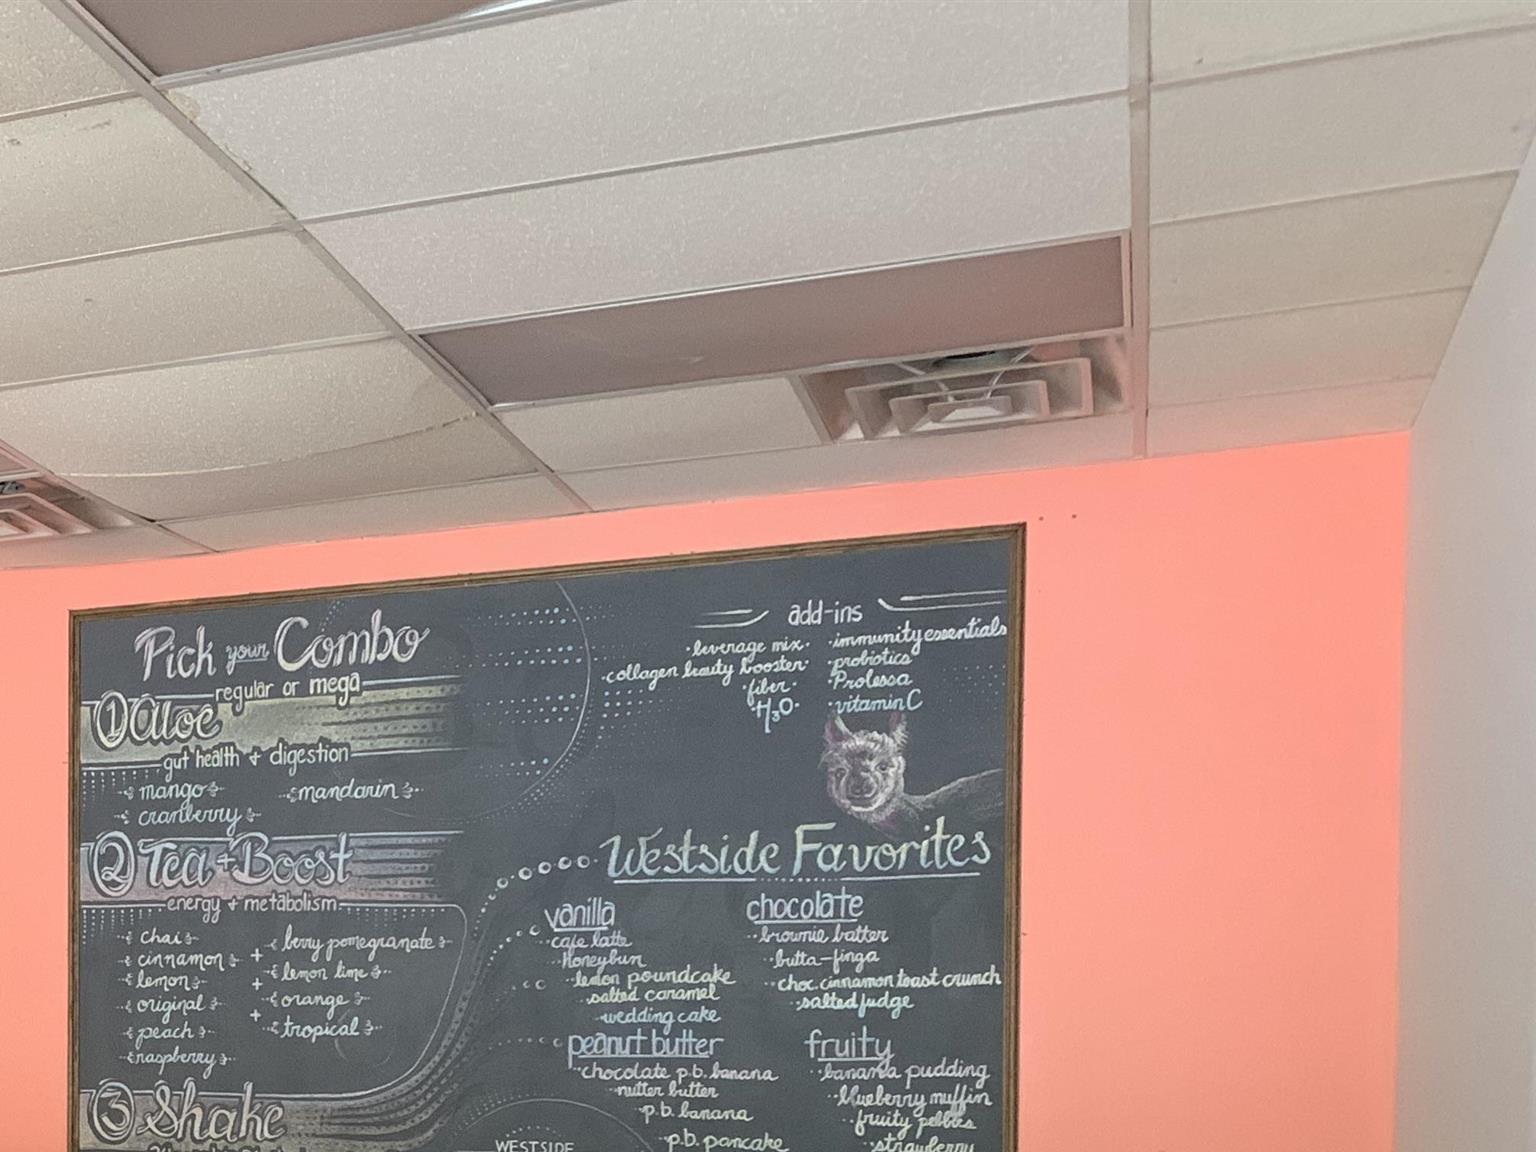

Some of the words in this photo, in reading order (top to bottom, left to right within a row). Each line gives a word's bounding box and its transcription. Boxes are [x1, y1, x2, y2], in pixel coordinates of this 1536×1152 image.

[787, 599, 863, 625] add-ins
[134, 625, 216, 682] Pick
[225, 642, 270, 674] your
[274, 608, 430, 671] Combo
[692, 640, 766, 662] leverage
[772, 636, 804, 652] mix
[832, 620, 923, 656] immunity
[924, 616, 1007, 641] essentials
[606, 663, 678, 691] collagen
[682, 659, 734, 686] beauty
[739, 656, 806, 675] booster
[830, 647, 913, 677] probiotics
[216, 679, 273, 712] regular
[282, 680, 300, 696] or
[310, 672, 360, 706] mega
[747, 678, 791, 706] fiber
[832, 669, 913, 690] Prolessa
[836, 694, 905, 714] vitamin
[906, 688, 923, 711] C
[164, 751, 188, 782] gut
[196, 746, 240, 768] health
[270, 742, 350, 776] digestion
[138, 782, 206, 810] mango
[298, 778, 399, 803] mandarin
[138, 804, 242, 836] cranberry
[138, 838, 213, 888] Tea
[230, 832, 353, 886] Boost
[599, 827, 782, 879] Westside
[791, 816, 992, 877] Favorites
[166, 898, 221, 923] energy
[244, 895, 337, 912] metabolism
[544, 896, 615, 928] vanilla
[746, 886, 864, 920] chocolate
[140, 928, 183, 945] chai
[282, 924, 323, 960] berry
[326, 927, 436, 962] pomegranate
[591, 930, 633, 948] latte
[758, 925, 830, 944] brownie
[831, 923, 889, 944] batter
[138, 952, 225, 972] cinnamon
[282, 962, 328, 982] lemon
[334, 960, 368, 980] lime
[773, 949, 880, 974] butta-finga
[135, 970, 189, 991] lemon
[628, 962, 736, 990] poundcake
[820, 976, 894, 990] cinnamon
[896, 968, 940, 989] toast
[942, 964, 1002, 988] crunch
[281, 994, 349, 1020] orange
[588, 987, 640, 1004] salted
[644, 984, 721, 1002] caramel
[796, 992, 857, 1011] salted
[137, 994, 206, 1024] original
[600, 1006, 675, 1035] wedding
[677, 1005, 722, 1024] cake
[135, 1026, 194, 1050] peach
[280, 1016, 360, 1043] tropical
[568, 1028, 649, 1069] peanut
[652, 1029, 725, 1056] butter
[804, 1026, 895, 1069] fruity
[134, 1046, 216, 1079] raspberry
[580, 1062, 672, 1080] chocolate
[710, 1062, 779, 1081] banana
[820, 1063, 902, 1082] banana
[904, 1056, 991, 1090] pudding
[616, 1082, 664, 1097] nutter
[668, 1080, 720, 1098] butter
[837, 1084, 928, 1117] blueberry
[929, 1083, 993, 1119] muffin
[136, 1077, 286, 1142] Shake
[678, 1101, 754, 1122] banana
[854, 1110, 913, 1140] fruity
